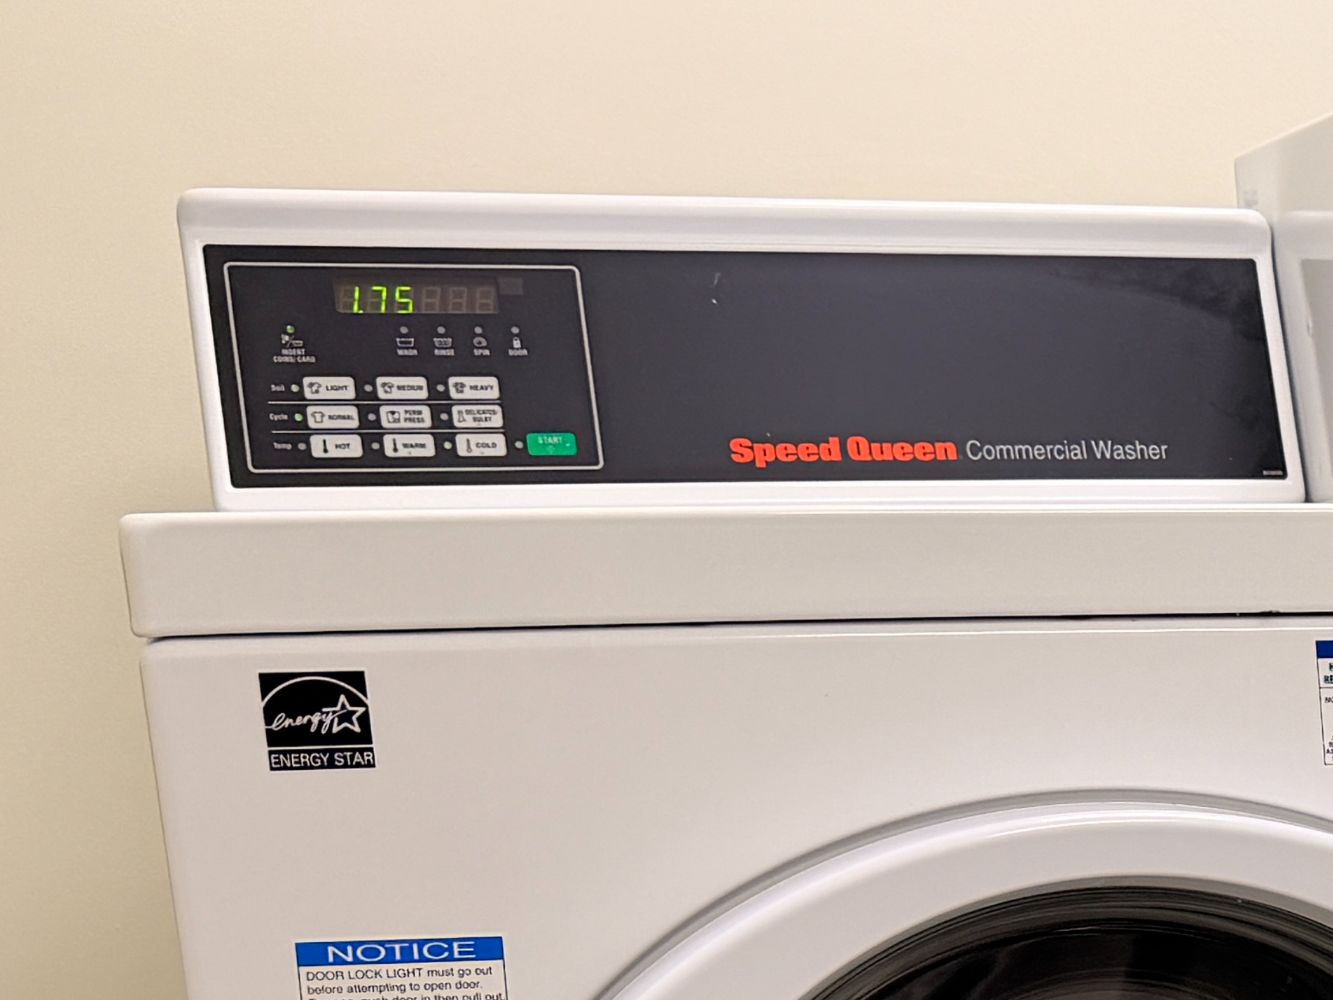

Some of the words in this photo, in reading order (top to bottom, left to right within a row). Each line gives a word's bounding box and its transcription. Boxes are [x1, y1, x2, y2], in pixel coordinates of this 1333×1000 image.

[353, 285, 414, 314] 1.75
[269, 412, 288, 421] Cycle
[475, 441, 498, 449] COLD
[538, 436, 563, 444] START
[729, 437, 841, 468] Speed
[846, 435, 958, 462] Queen
[966, 438, 1087, 461] Commercial
[1092, 441, 1169, 461] Washer
[268, 711, 335, 735] energy
[270, 752, 330, 768] ENERGY
[334, 751, 373, 766] STAR
[327, 940, 476, 963] NOTICE
[306, 970, 345, 981] DOOR
[349, 969, 383, 981] LOCK
[386, 967, 422, 979] LIGHT
[427, 968, 454, 978] must
[458, 968, 471, 979] go
[475, 966, 492, 976] out
[307, 984, 343, 995] before
[346, 982, 407, 995] attempting
[409, 982, 421, 991] to
[423, 981, 453, 992] open
[455, 980, 483, 990] door.
